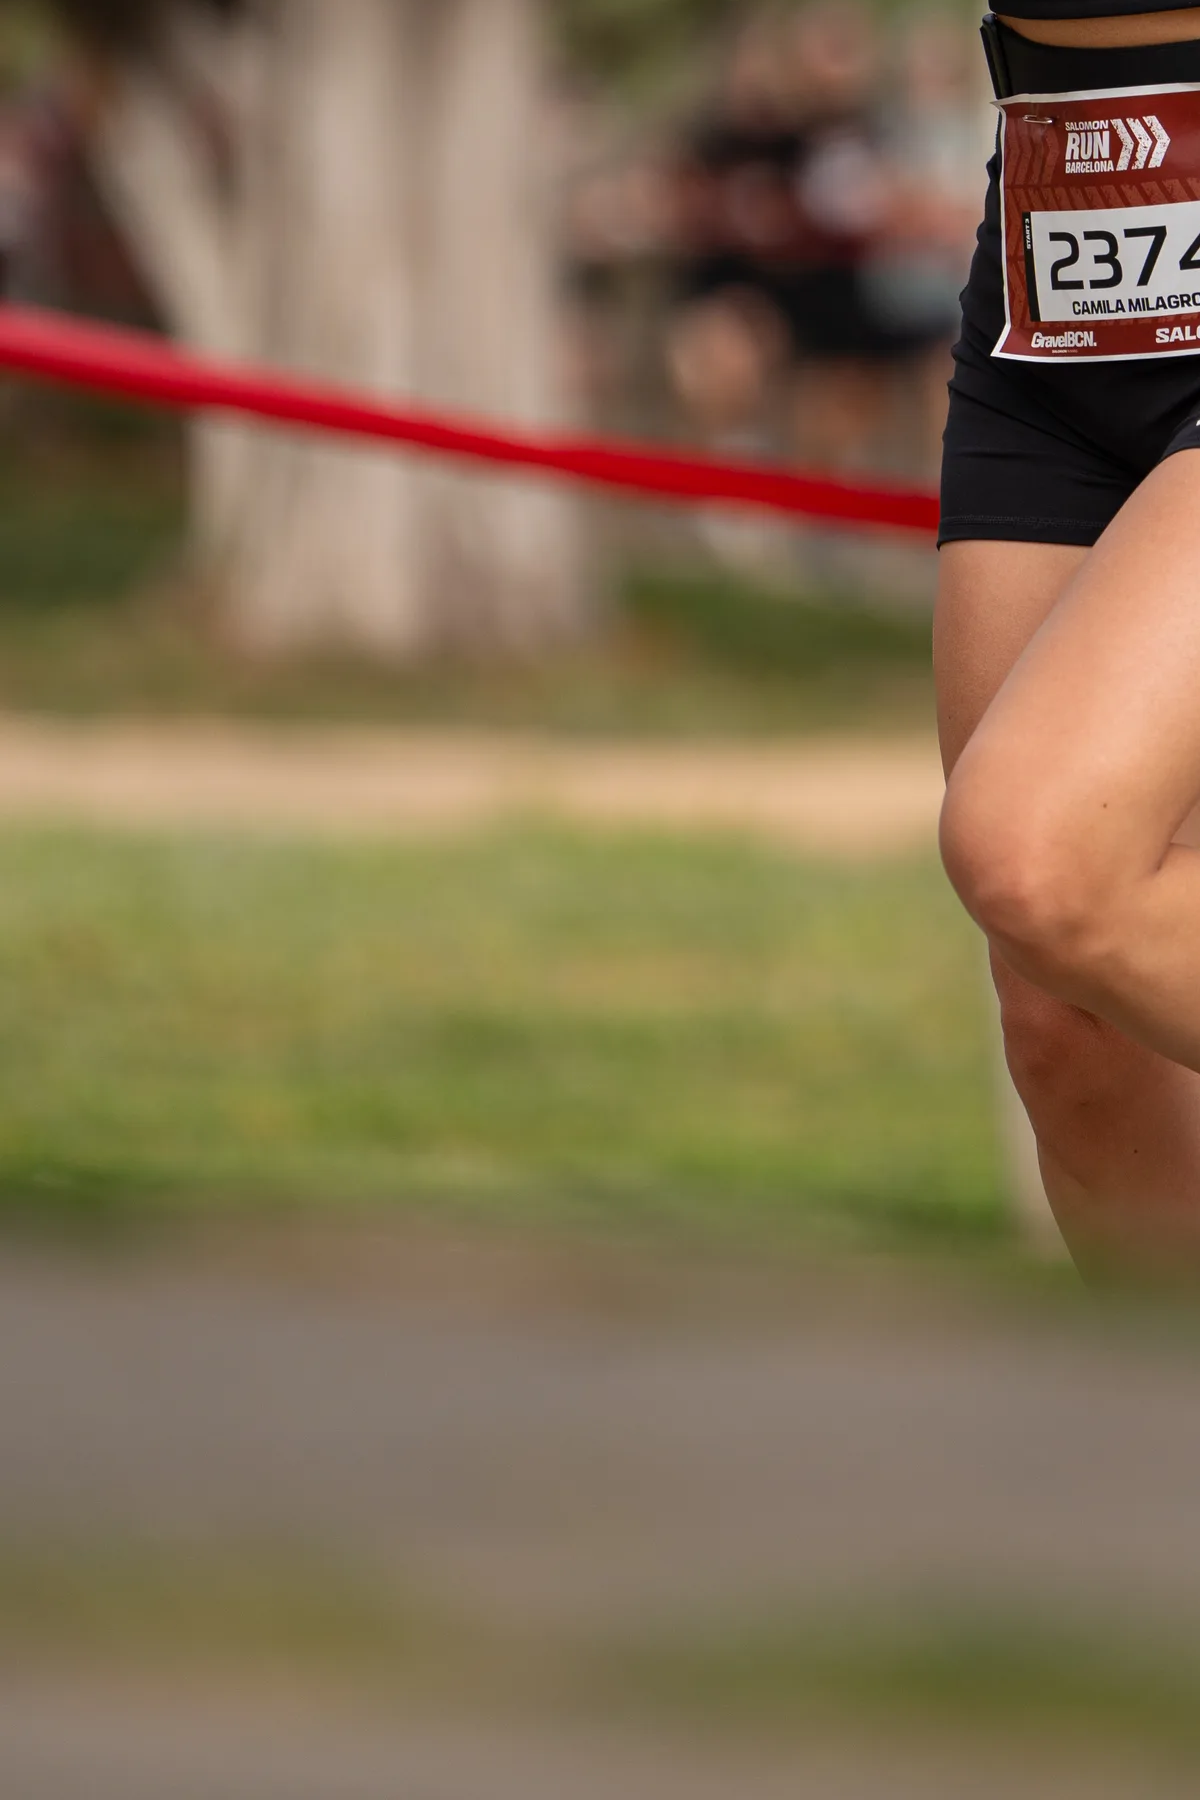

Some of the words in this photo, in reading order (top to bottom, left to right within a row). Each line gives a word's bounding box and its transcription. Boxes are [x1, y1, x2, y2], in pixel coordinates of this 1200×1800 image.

[1065, 119, 1109, 131] SALOMON
[1065, 130, 1110, 161] RUN
[1065, 160, 1115, 174] BARCELONA
[1072, 298, 1127, 316] CAMILA
[1031, 330, 1098, 349] GravelBCN.
